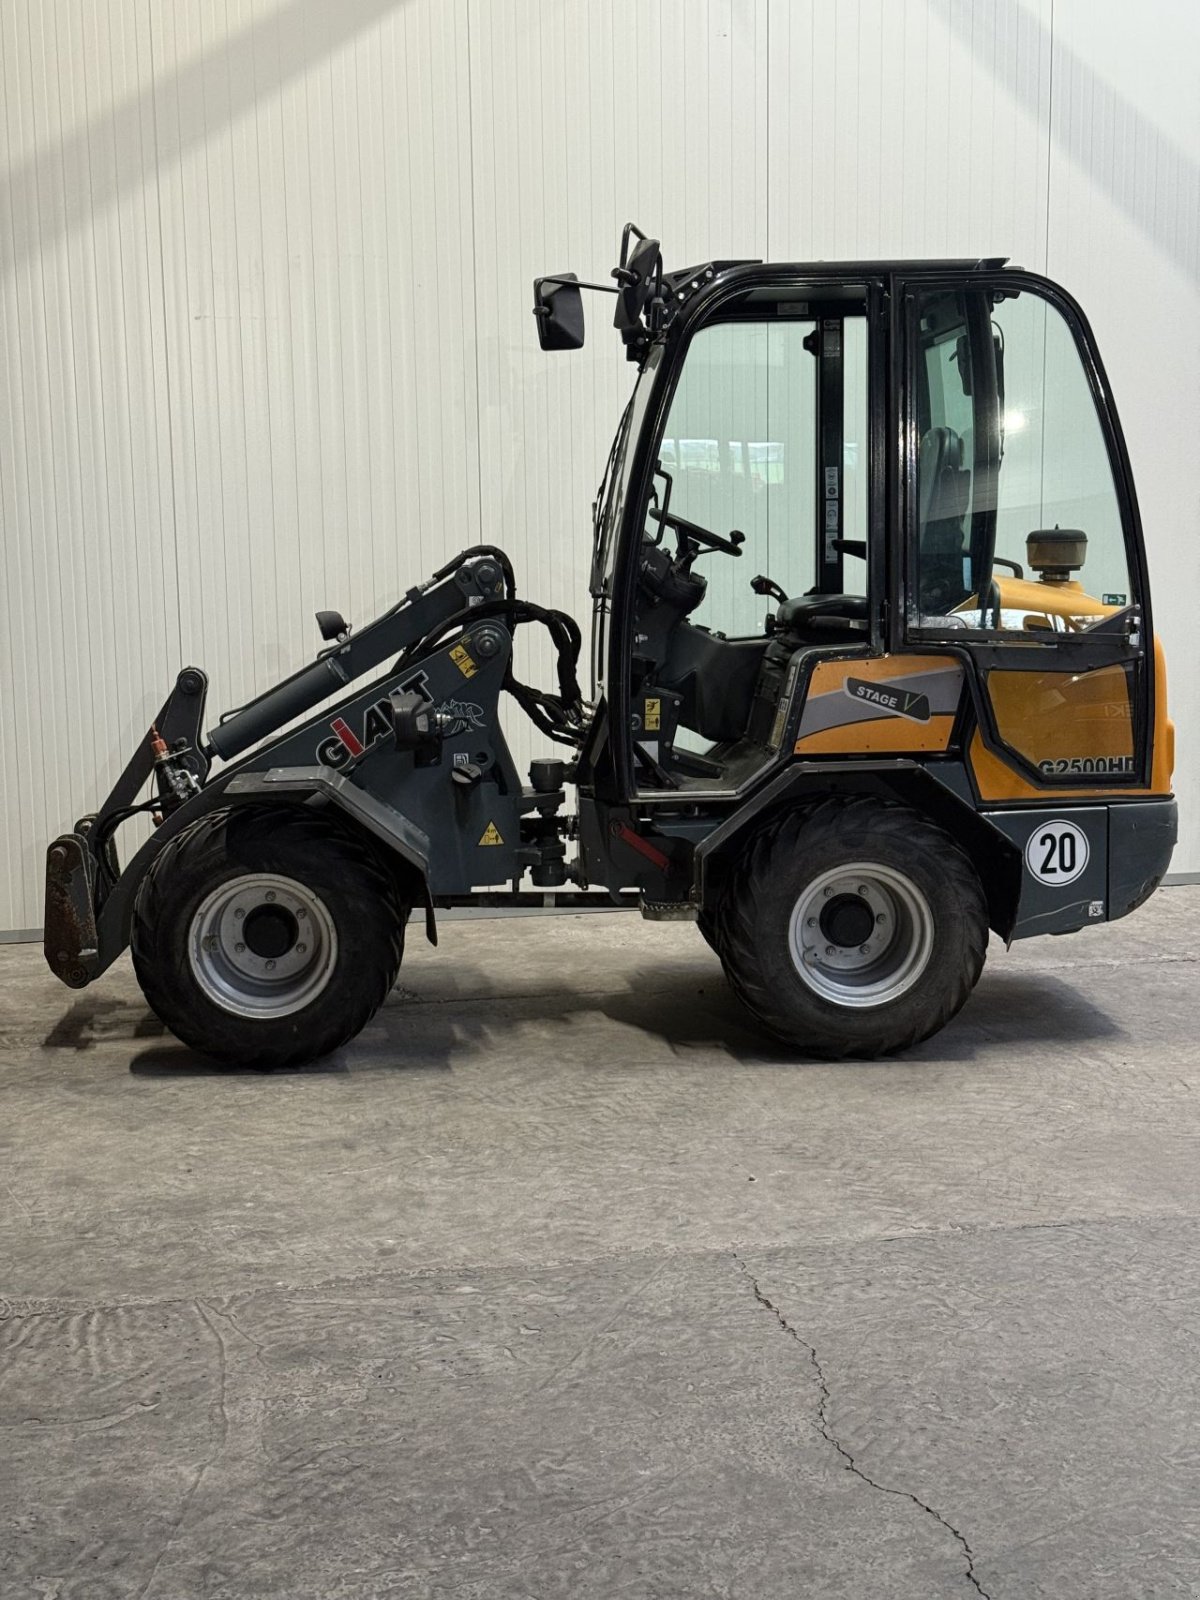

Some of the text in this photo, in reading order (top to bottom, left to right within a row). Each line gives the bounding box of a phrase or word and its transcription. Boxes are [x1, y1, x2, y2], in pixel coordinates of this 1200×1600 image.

[857, 686, 926, 711] STAGE V
[1040, 832, 1076, 874] 20
